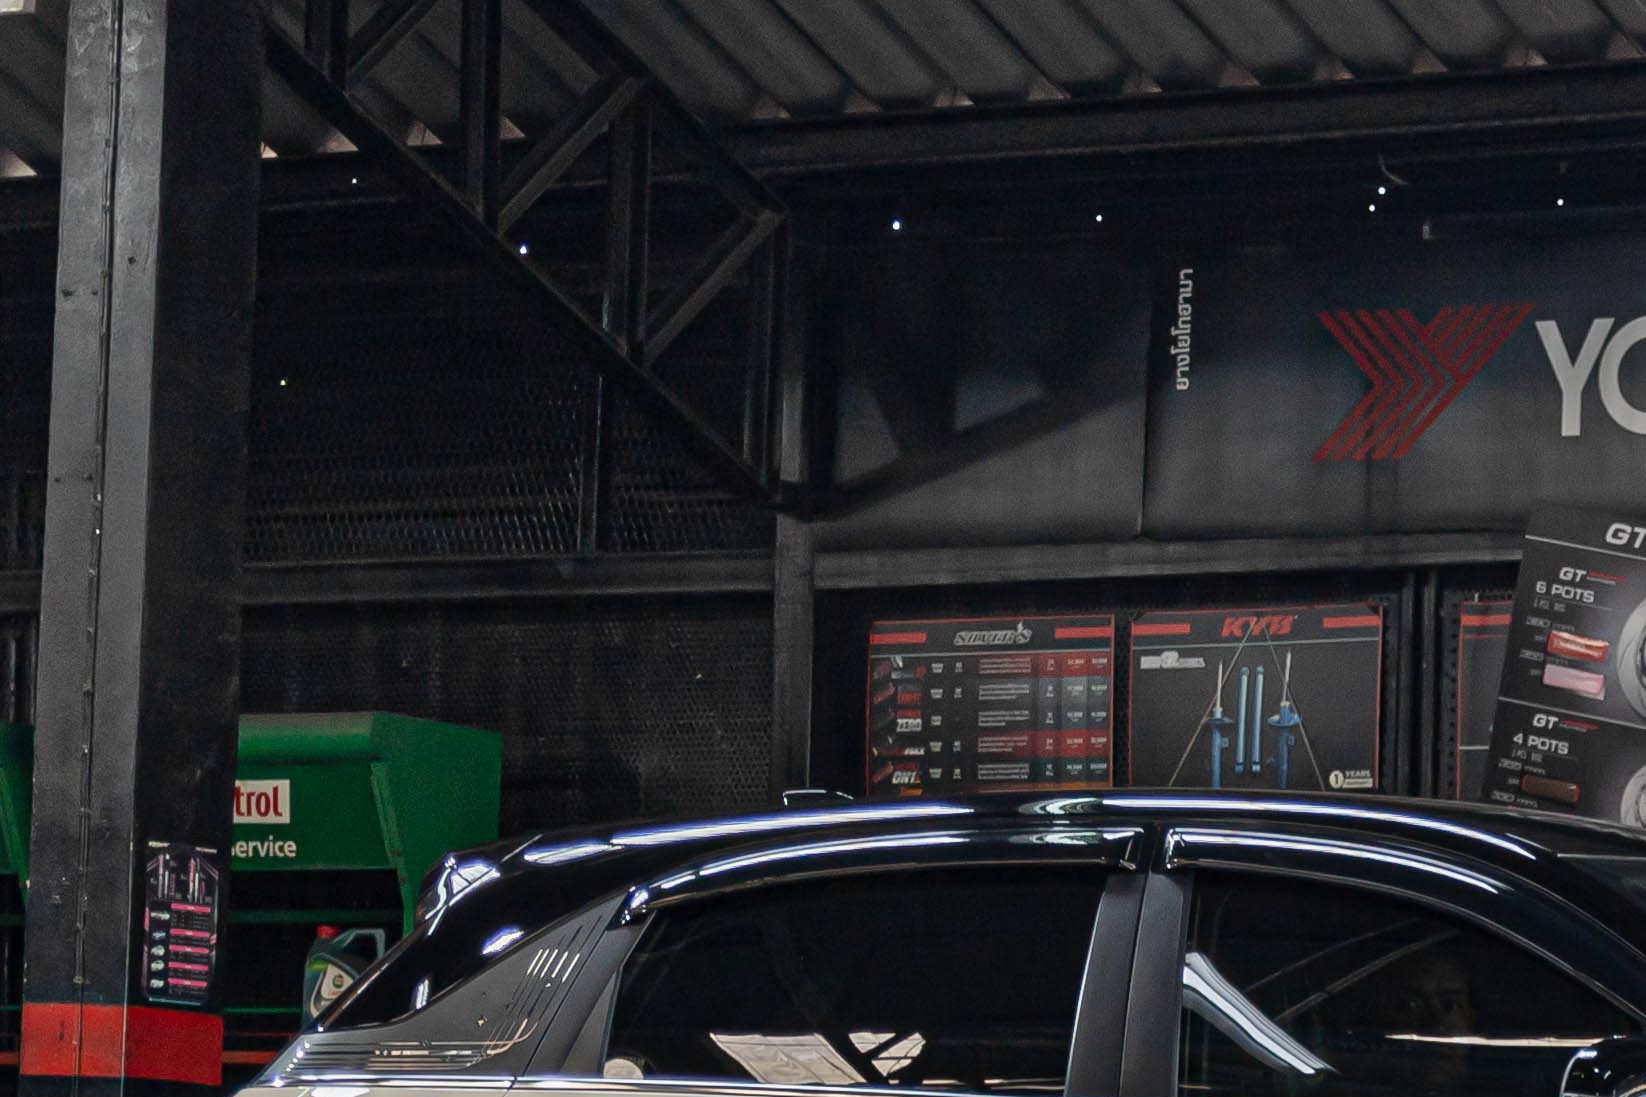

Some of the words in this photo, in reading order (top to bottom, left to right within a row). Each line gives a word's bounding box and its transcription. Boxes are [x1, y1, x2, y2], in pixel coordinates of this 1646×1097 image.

[1170, 268, 1194, 391] ยางโยโกฮามา
[1559, 566, 1588, 583] GT
[1551, 583, 1596, 604] POTS
[1220, 614, 1297, 639] KYB
[1532, 713, 1560, 731] GT
[1512, 731, 1524, 745] 4
[1526, 734, 1570, 756] POTS
[231, 835, 298, 858] ervice
